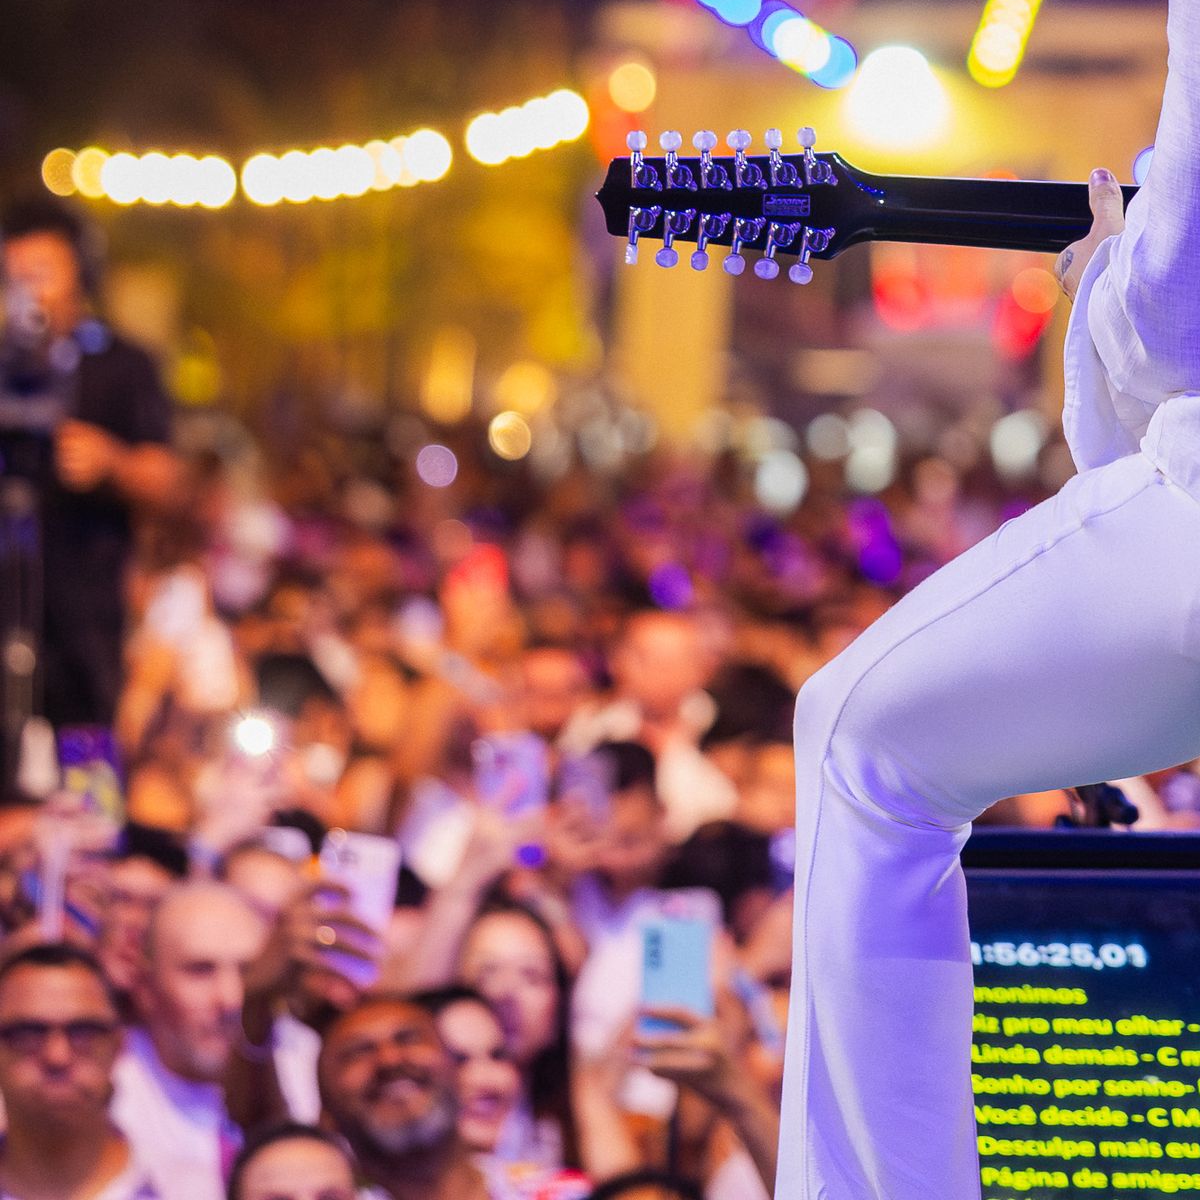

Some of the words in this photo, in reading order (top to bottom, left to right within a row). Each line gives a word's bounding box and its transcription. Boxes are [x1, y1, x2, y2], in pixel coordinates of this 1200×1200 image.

[1003, 1017, 1049, 1037] pro
[1052, 1018, 1113, 1034] meu
[1115, 1015, 1185, 1036] olhar
[971, 1043, 1041, 1064] Linda
[1043, 1044, 1139, 1066] demais
[1157, 1046, 1179, 1066] C
[971, 1074, 1051, 1095] Sonho
[1053, 1079, 1101, 1098] por
[1039, 1105, 1128, 1127] decide
[1146, 1107, 1169, 1127] C
[977, 1136, 1096, 1160] Desculpe
[1099, 1138, 1163, 1158] mais
[1072, 1167, 1108, 1188] de
